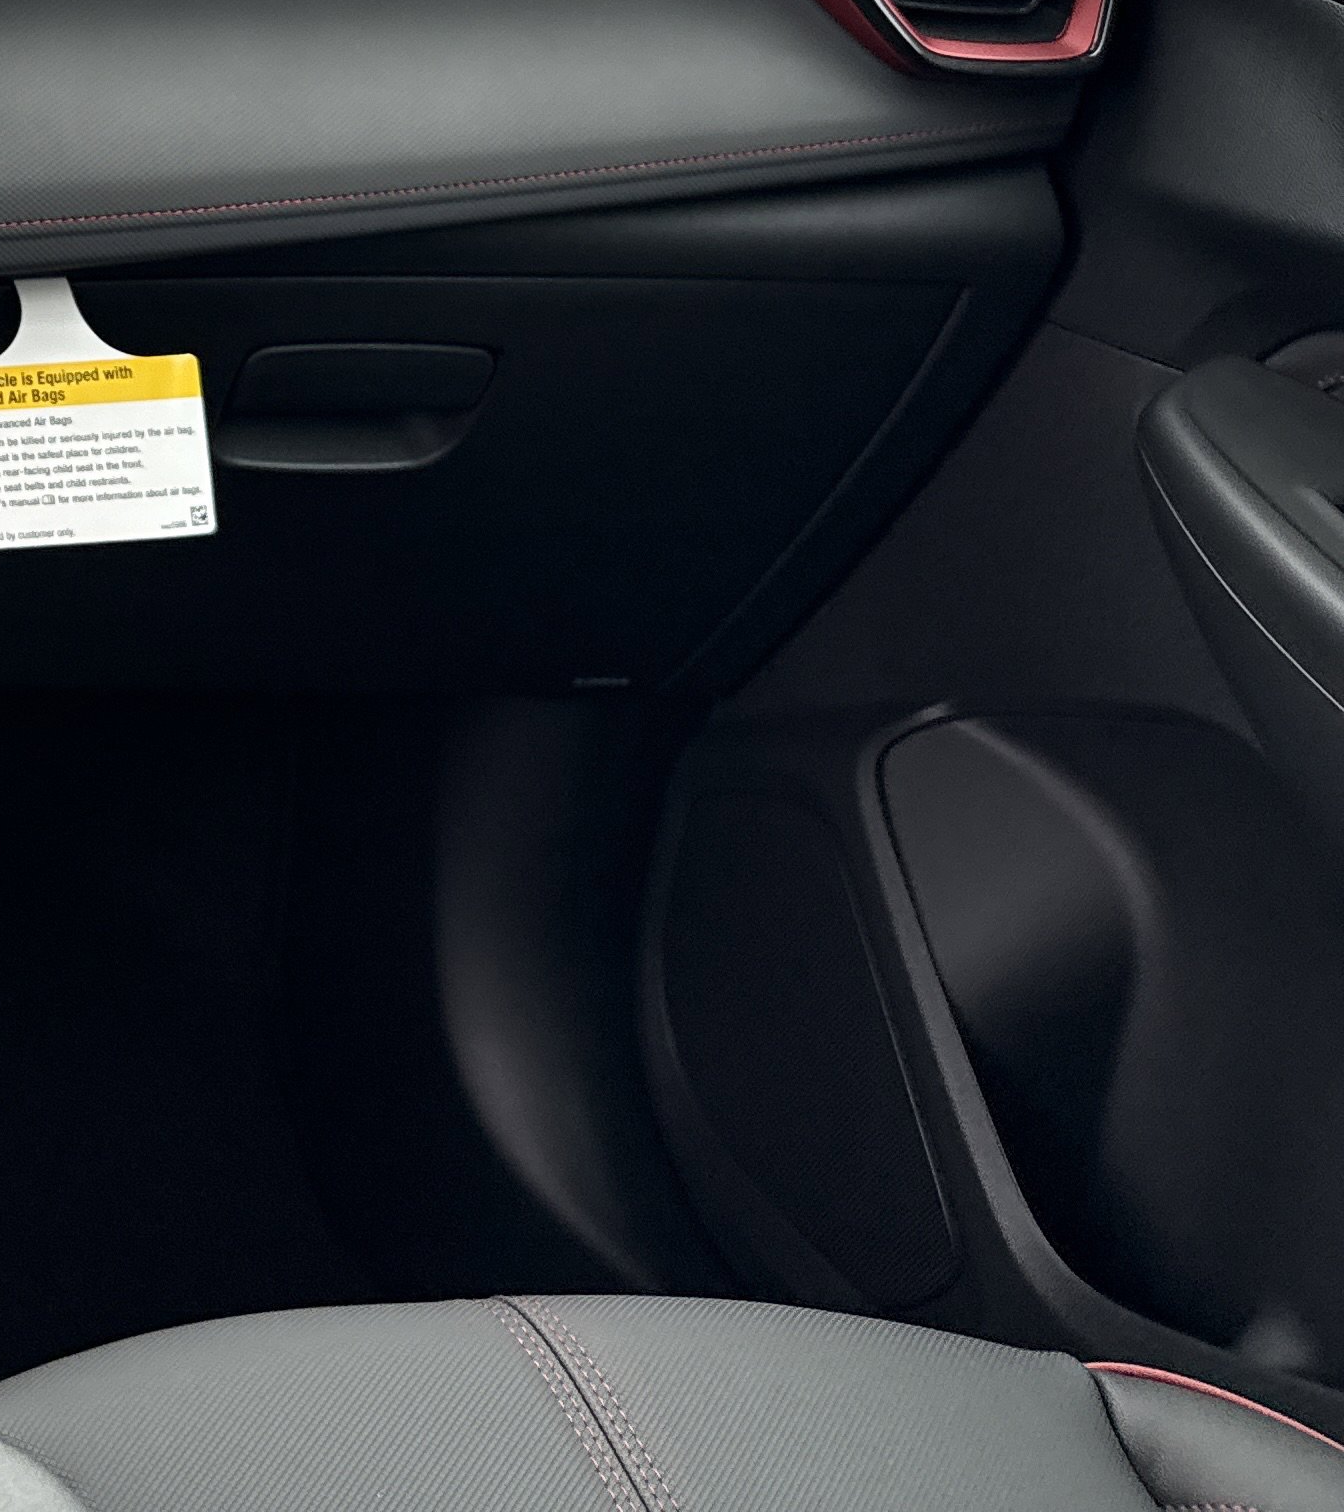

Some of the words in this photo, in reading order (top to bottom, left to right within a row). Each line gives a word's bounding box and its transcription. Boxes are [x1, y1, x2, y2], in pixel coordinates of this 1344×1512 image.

[21, 372, 34, 386] is
[37, 368, 100, 386] Equipped
[103, 365, 133, 380] with
[8, 390, 28, 404] Air
[31, 388, 66, 405] Bags
[34, 417, 47, 426] Air
[49, 415, 72, 426] Bags
